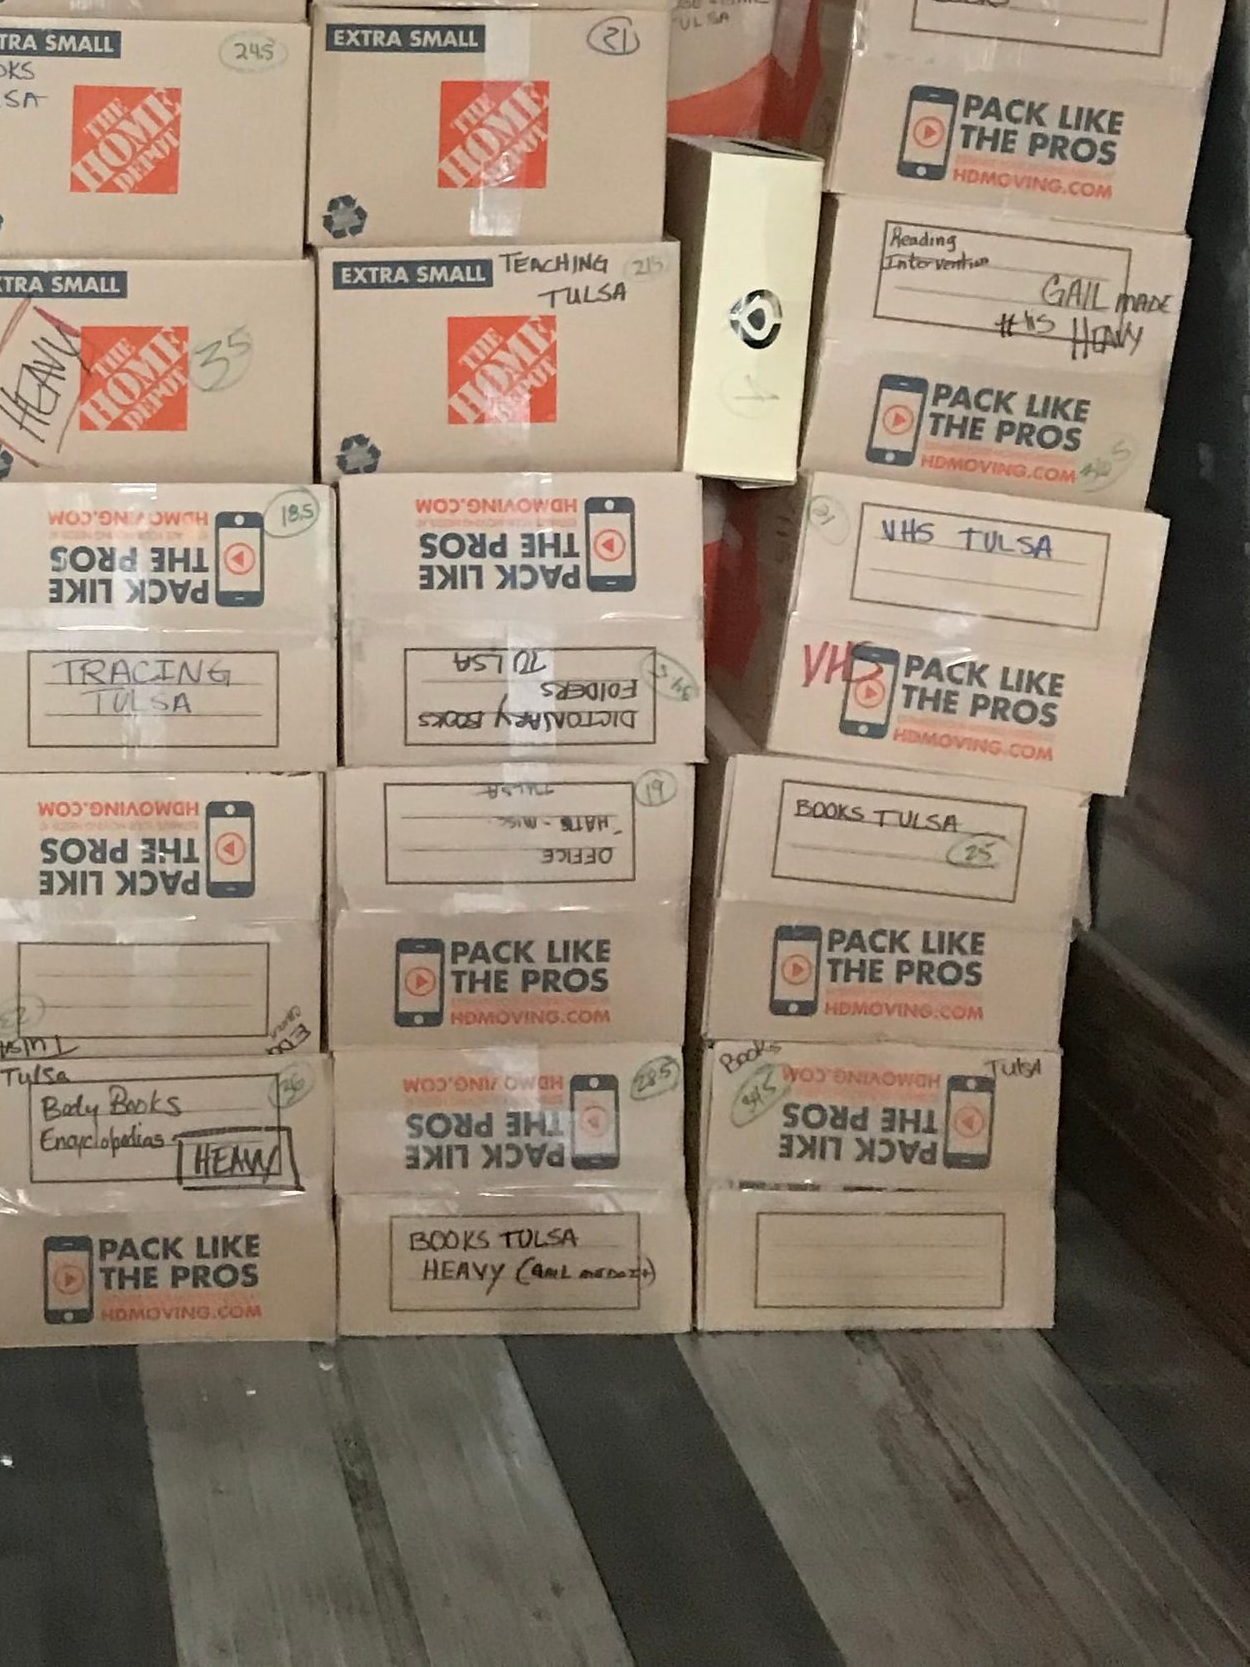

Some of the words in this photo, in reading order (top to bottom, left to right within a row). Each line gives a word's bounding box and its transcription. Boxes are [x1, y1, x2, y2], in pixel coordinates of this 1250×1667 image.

[889, 226, 957, 251] Reading
[340, 266, 409, 284] EXTRA
[416, 265, 486, 283] SMALL
[499, 252, 608, 274] TEACHING
[51, 275, 120, 294] SMALL
[537, 284, 627, 309] TULSA
[1041, 274, 1109, 313] GAIL
[881, 519, 935, 544] VHS
[959, 527, 1052, 560] TULSA
[51, 657, 233, 686] TRACING
[903, 653, 992, 690] PACK
[1000, 666, 1066, 698] LIKE
[80, 689, 192, 714] TULSA
[901, 683, 960, 715] THE
[968, 692, 1060, 728] PROS
[417, 711, 483, 729] BOOKS
[793, 798, 865, 822] BOOKS
[873, 808, 960, 834] TULSA
[540, 847, 613, 864] OFFICE
[451, 941, 537, 965] PACK
[546, 939, 611, 964] LIKE
[451, 970, 509, 993] THE
[520, 968, 609, 992] PROS
[39, 1096, 100, 1119] Body
[108, 1086, 183, 1116] Books
[410, 1229, 490, 1252] BOOKS
[500, 1228, 578, 1249] TULSA
[423, 1258, 506, 1296] HEAVY
